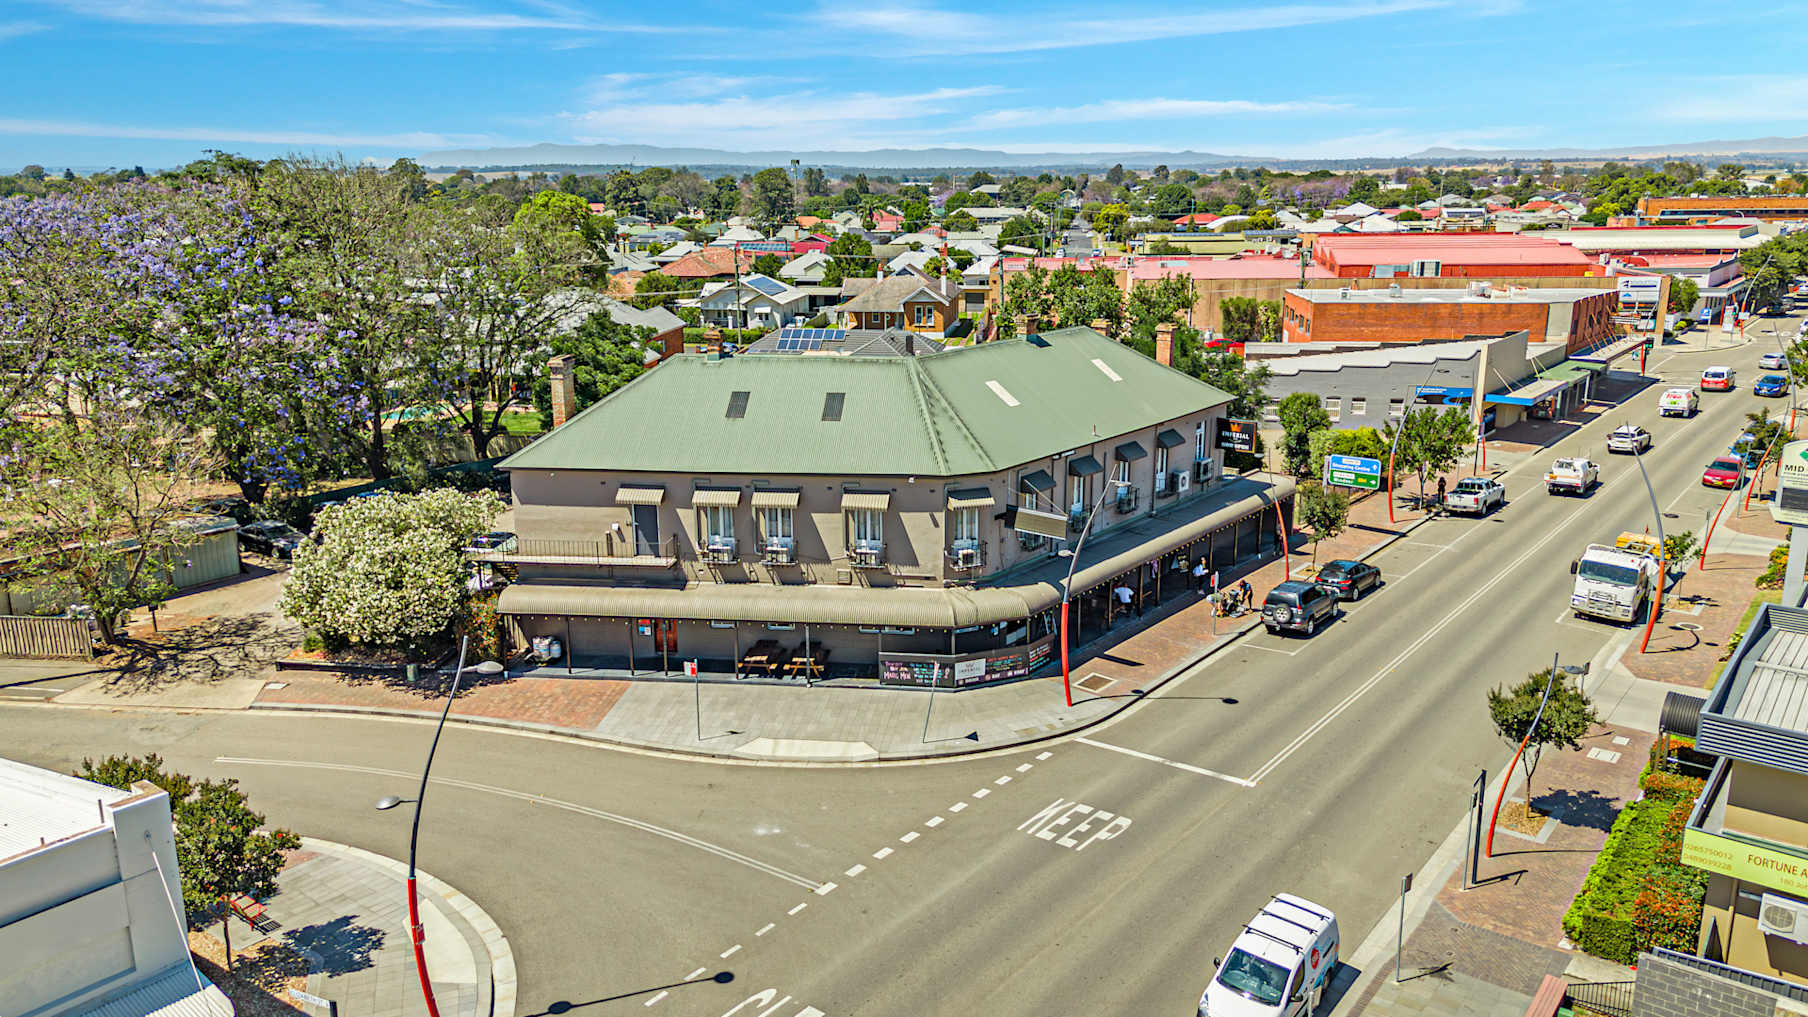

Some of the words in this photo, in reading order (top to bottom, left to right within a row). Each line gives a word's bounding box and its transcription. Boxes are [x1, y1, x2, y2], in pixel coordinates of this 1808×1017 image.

[1221, 431, 1250, 440] IMPERIAL
[1016, 798, 1133, 851] KEEP
[1747, 854, 1799, 875] FORTUNE
